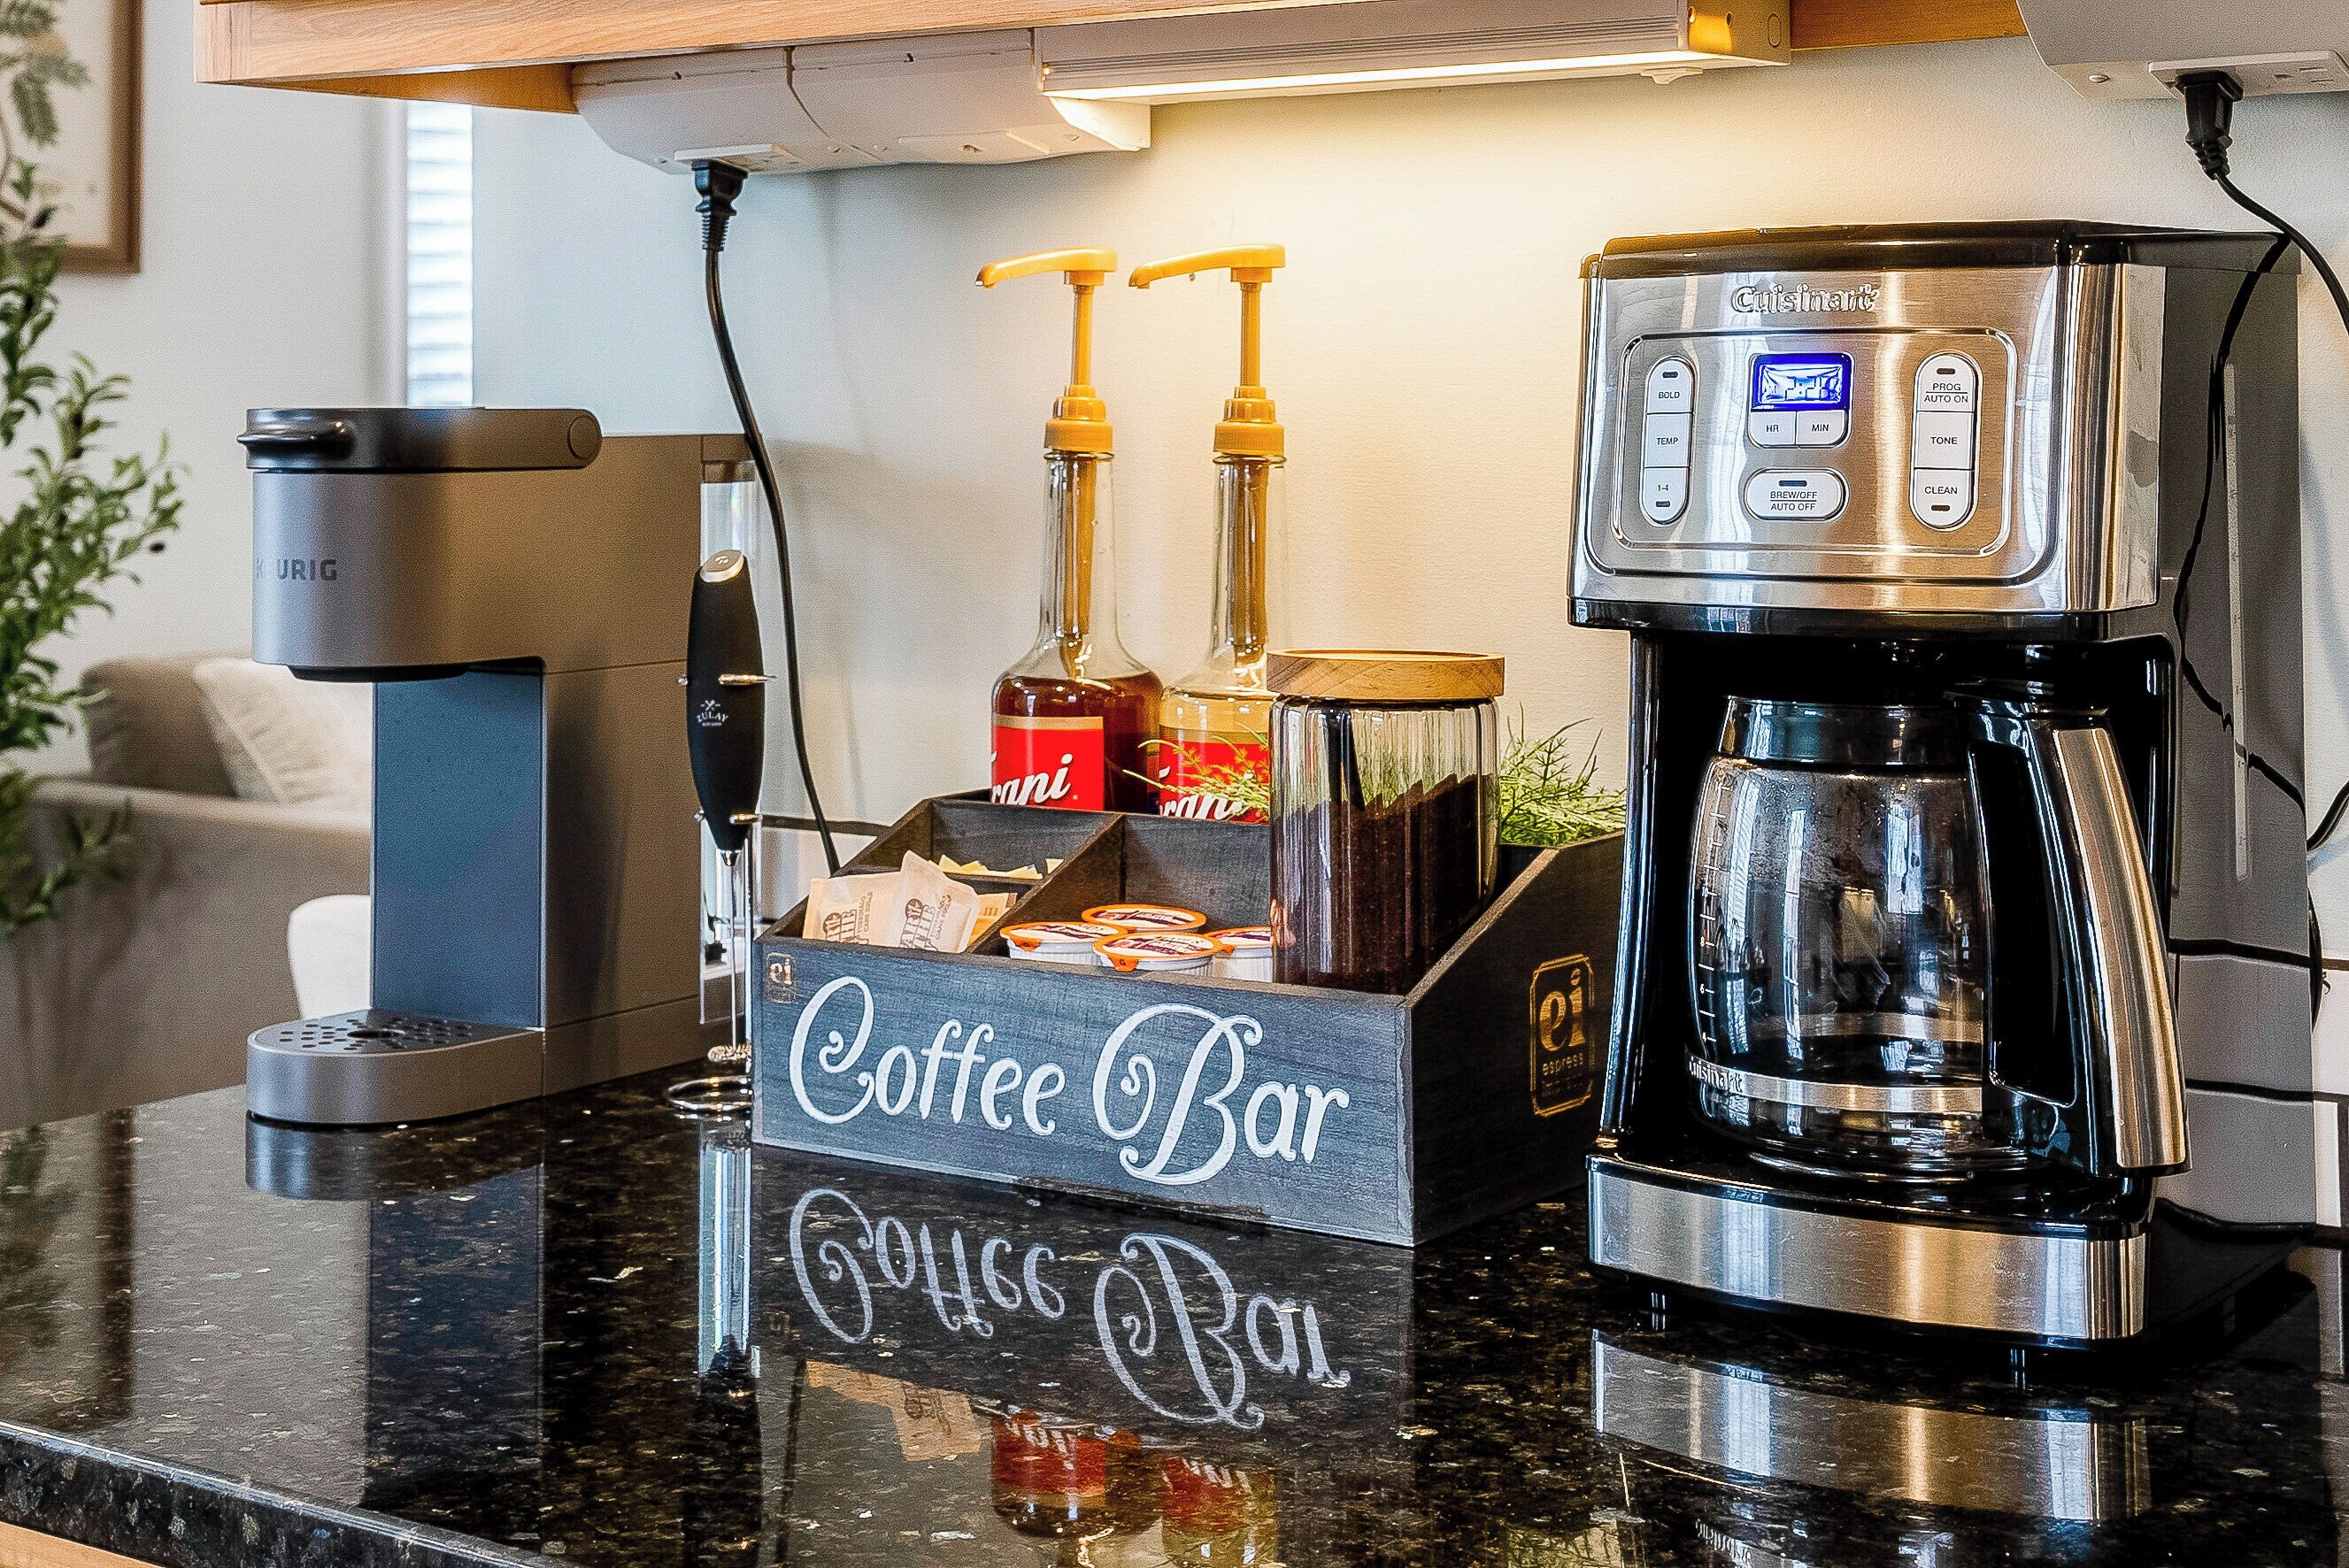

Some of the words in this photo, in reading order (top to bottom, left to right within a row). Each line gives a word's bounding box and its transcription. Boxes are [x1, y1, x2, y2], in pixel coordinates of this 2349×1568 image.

[1731, 282, 1880, 314] Cuisinart
[1932, 382, 1961, 391] PROG
[1923, 395, 1952, 404] AUTO
[1766, 424, 1779, 433] HR
[1930, 436, 1958, 445] TONE
[1657, 483, 1669, 492] 1-4
[1924, 486, 1958, 495] CLEAN
[1770, 491, 1818, 500] BREW/OFF
[256, 557, 337, 581] KURIG
[991, 751, 1072, 805] rani
[1699, 983, 1705, 994] 6
[1540, 968, 1586, 1050] ei
[789, 975, 1066, 1136] Coffee
[1092, 1003, 1351, 1185] Bar
